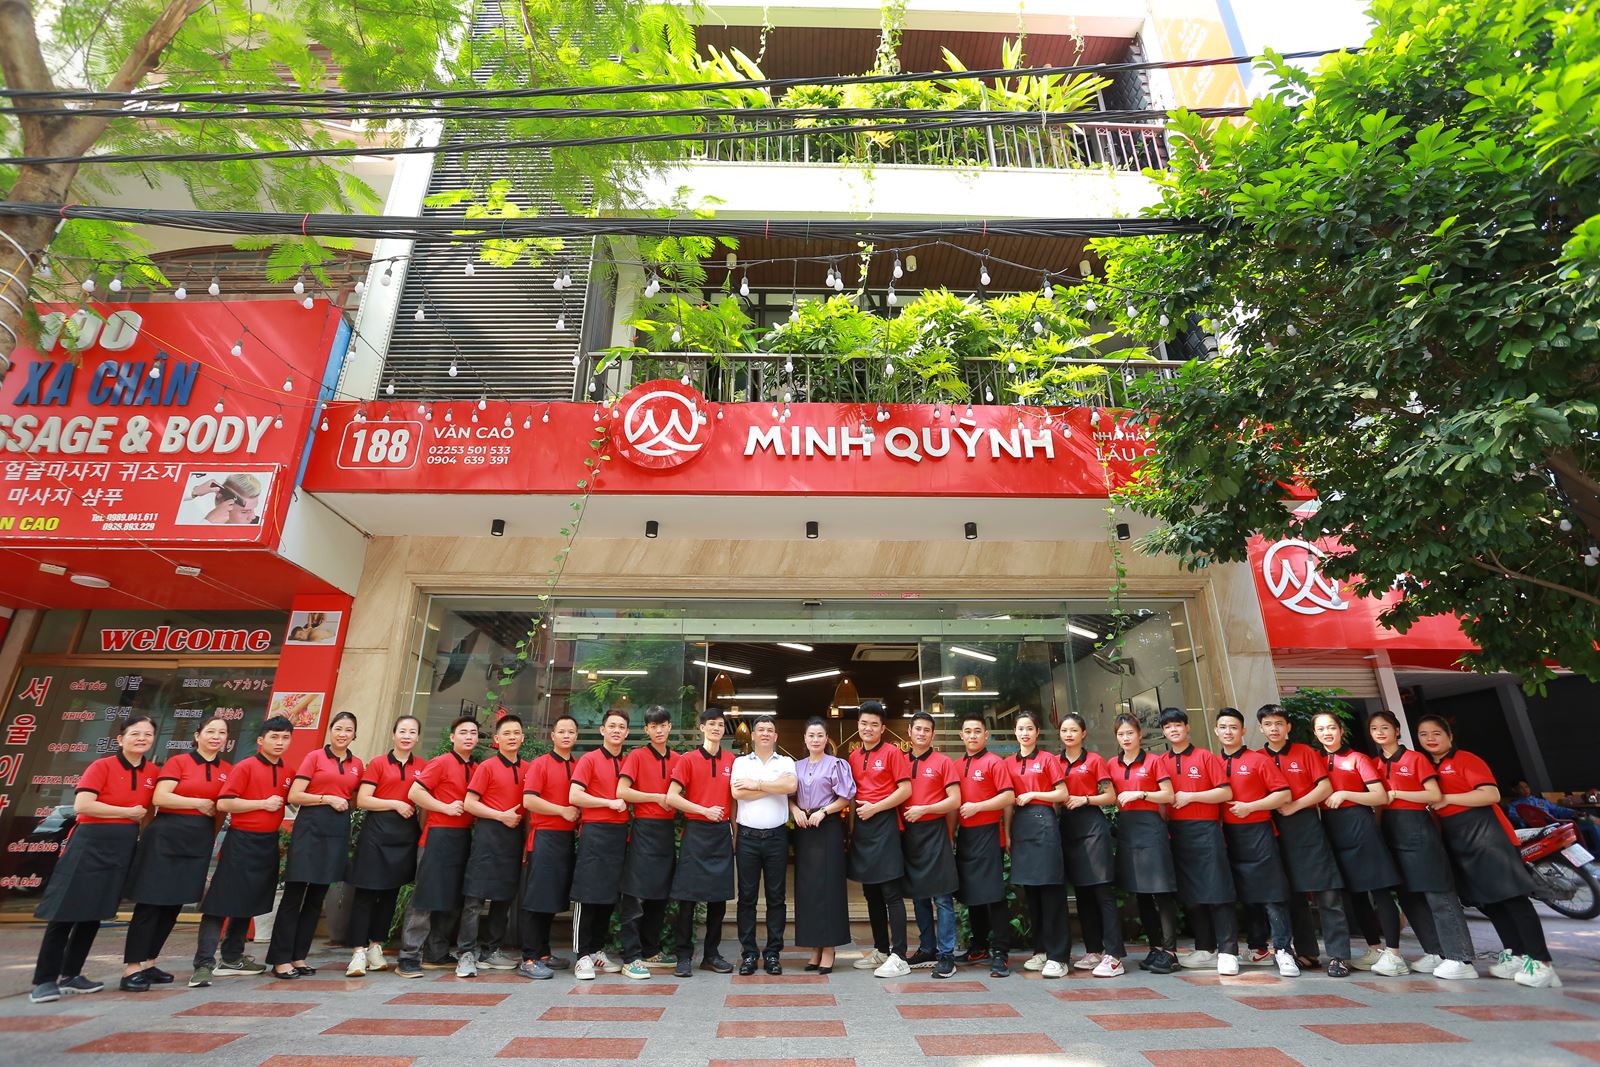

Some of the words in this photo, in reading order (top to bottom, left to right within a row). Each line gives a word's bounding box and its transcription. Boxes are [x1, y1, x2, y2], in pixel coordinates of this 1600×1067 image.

[120, 415, 152, 453] &
[158, 415, 273, 453] BODY
[433, 424, 470, 439] VĂN
[475, 427, 515, 439] CAO
[743, 425, 873, 456] MINH
[884, 417, 1055, 462] QUỲNH
[352, 429, 409, 463] 188
[428, 446, 465, 455] 02253
[467, 446, 487, 455] 501
[489, 446, 511, 455] 533
[426, 456, 457, 464] 0904
[463, 456, 485, 464] 639
[490, 456, 508, 464] 391
[4, 461, 110, 481] 얼굴마사지
[119, 461, 182, 482] 귀소지
[7, 487, 73, 506] 마사지
[81, 488, 124, 507] 샴푸
[19, 516, 60, 531] CAO
[101, 626, 271, 652] welcome
[115, 675, 143, 691] 이발
